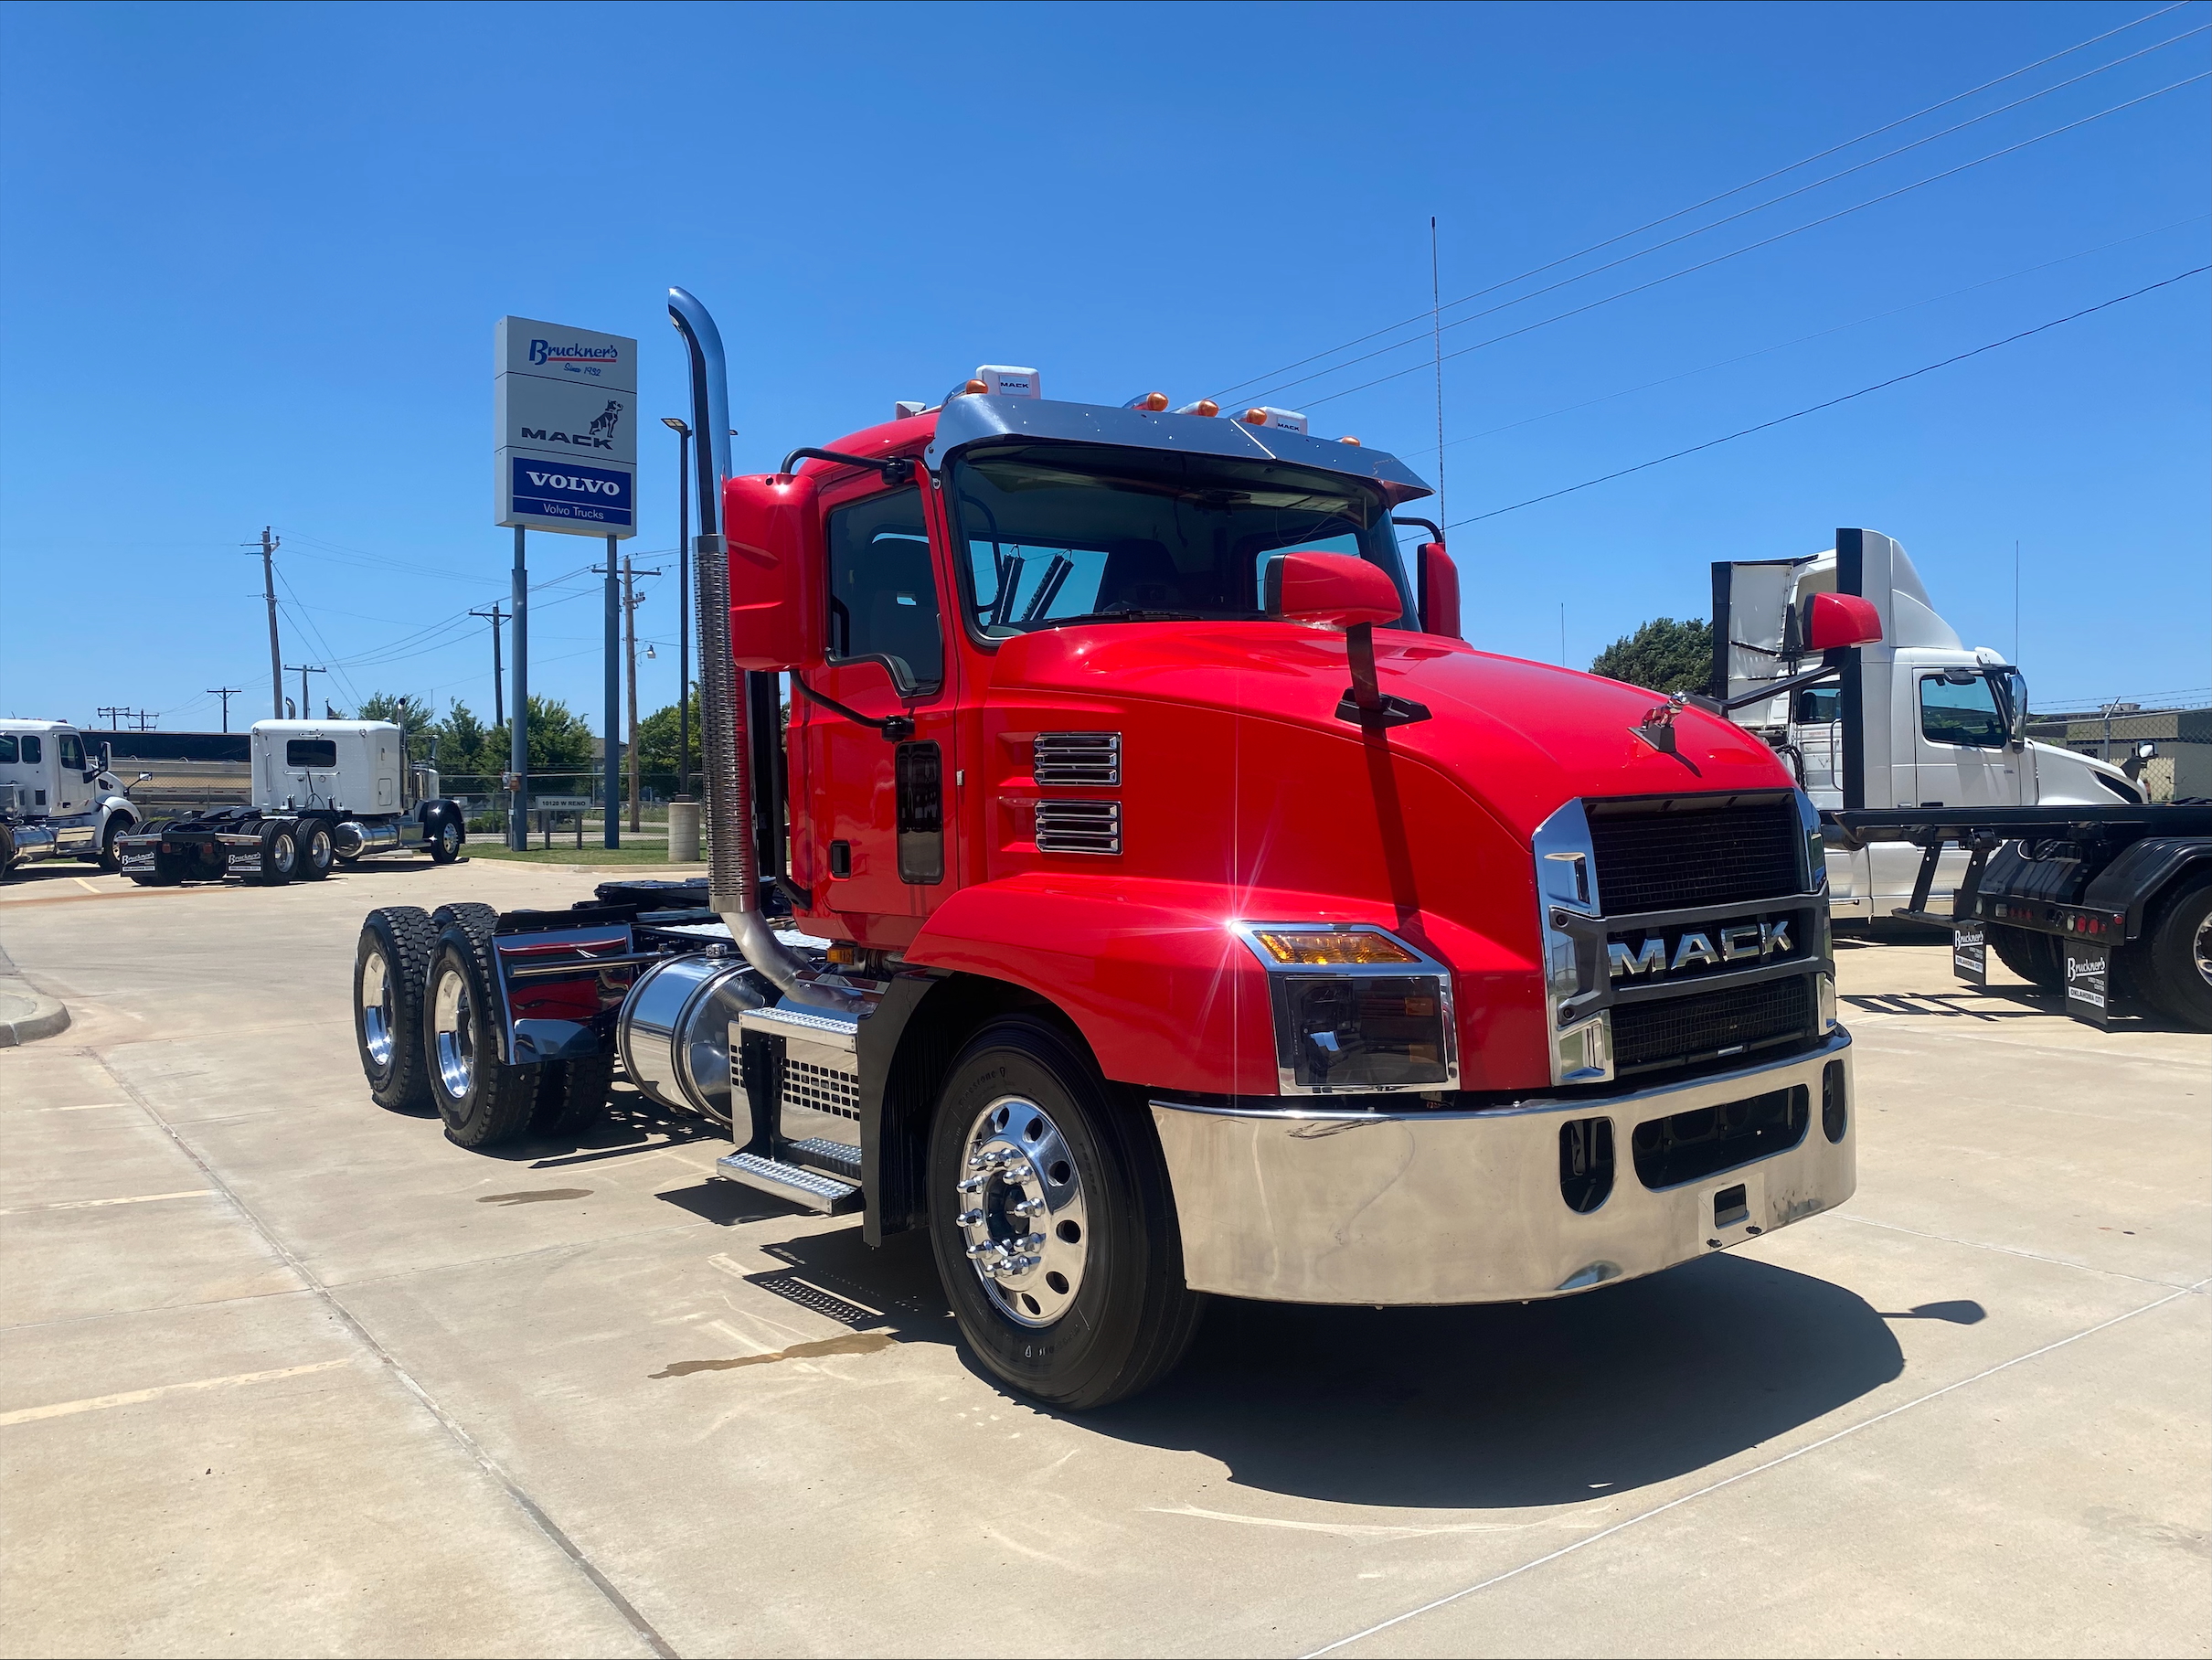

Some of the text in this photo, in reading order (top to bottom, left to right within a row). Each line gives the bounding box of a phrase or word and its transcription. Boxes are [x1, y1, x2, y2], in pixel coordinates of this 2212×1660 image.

[528, 339, 618, 366] Bruckner's
[521, 427, 613, 451] MACK
[526, 471, 620, 496] VOLVO
[543, 503, 604, 520] Volvo Trucks
[1607, 920, 1793, 977] MACK
[1954, 930, 1983, 951] Bruckner's
[2068, 956, 2105, 982] Bruckner's
[2070, 988, 2103, 1005] OKLAHOMA CITY
[959, 1069, 996, 1108] Firestone
